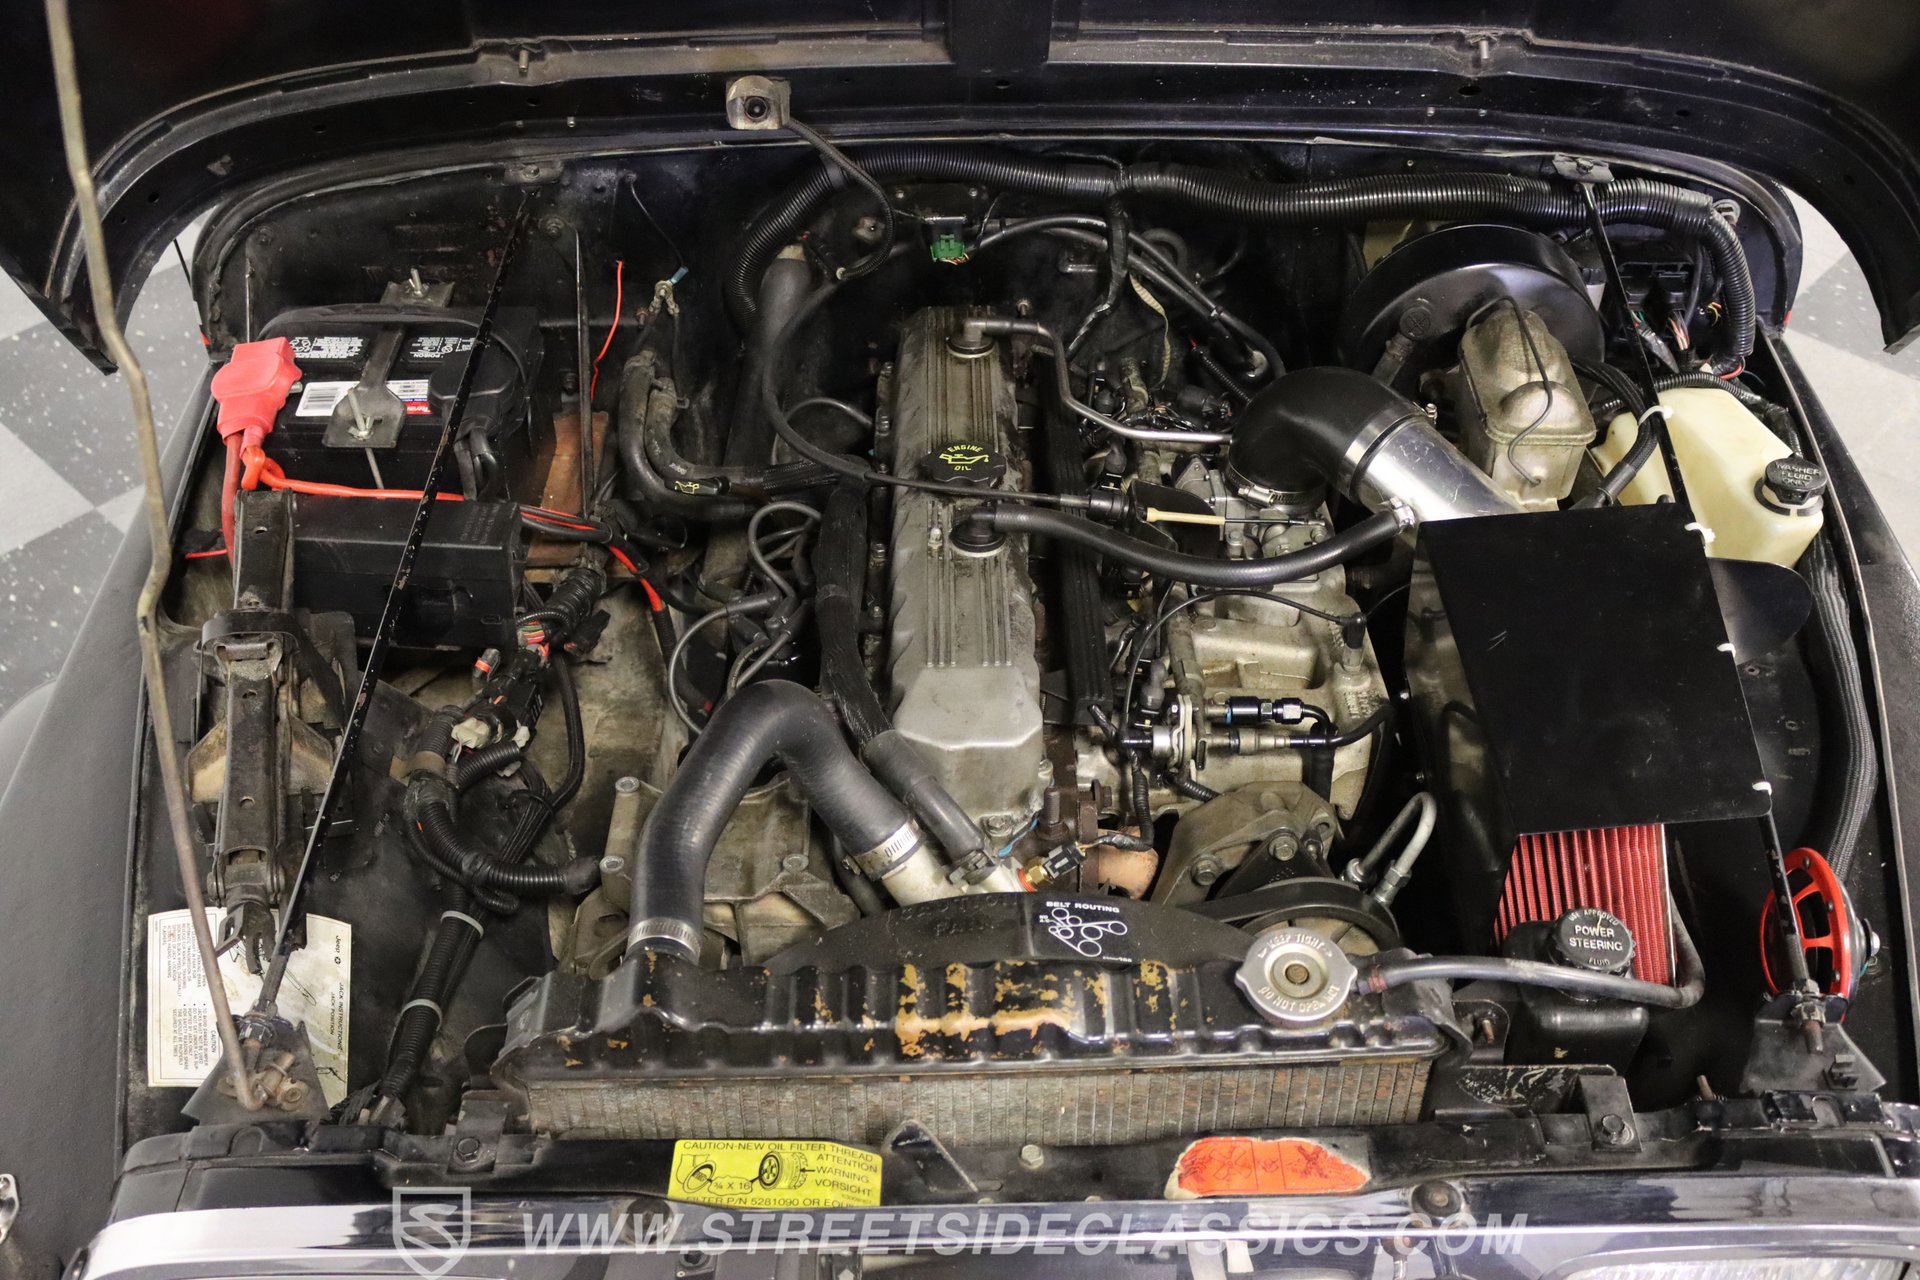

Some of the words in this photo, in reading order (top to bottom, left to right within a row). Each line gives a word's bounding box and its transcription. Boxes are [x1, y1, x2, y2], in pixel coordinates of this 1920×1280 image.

[947, 444, 983, 452] ENGINE
[1776, 464, 1821, 475] WASHER
[1781, 471, 1812, 480] FLUID
[1782, 477, 1810, 487] ONLY
[1074, 902, 1120, 913] ROUTING
[1568, 911, 1580, 921] USE
[1584, 909, 1619, 926] APPROVED
[1574, 925, 1615, 938] POWER
[1266, 933, 1291, 950] KEEP
[1294, 933, 1325, 949] TIGHT
[1569, 937, 1623, 951] STEERING
[1588, 957, 1610, 965] FLUID
[1257, 985, 1273, 1000] DO
[1272, 998, 1295, 1012] NOT
[683, 1141, 764, 1151] CAUTION-NEW
[768, 1143, 786, 1151] OIL
[790, 1143, 826, 1152] FILTER
[832, 1145, 873, 1163] THREAD
[816, 1153, 878, 1173] ATTENTION
[816, 1166, 869, 1184] WARNING
[739, 1182, 750, 1190] 16
[815, 1179, 872, 1197] VORSICHT
[727, 1197, 747, 1206] P/N
[751, 1197, 799, 1206] 5281090
[803, 1198, 821, 1207] OR
